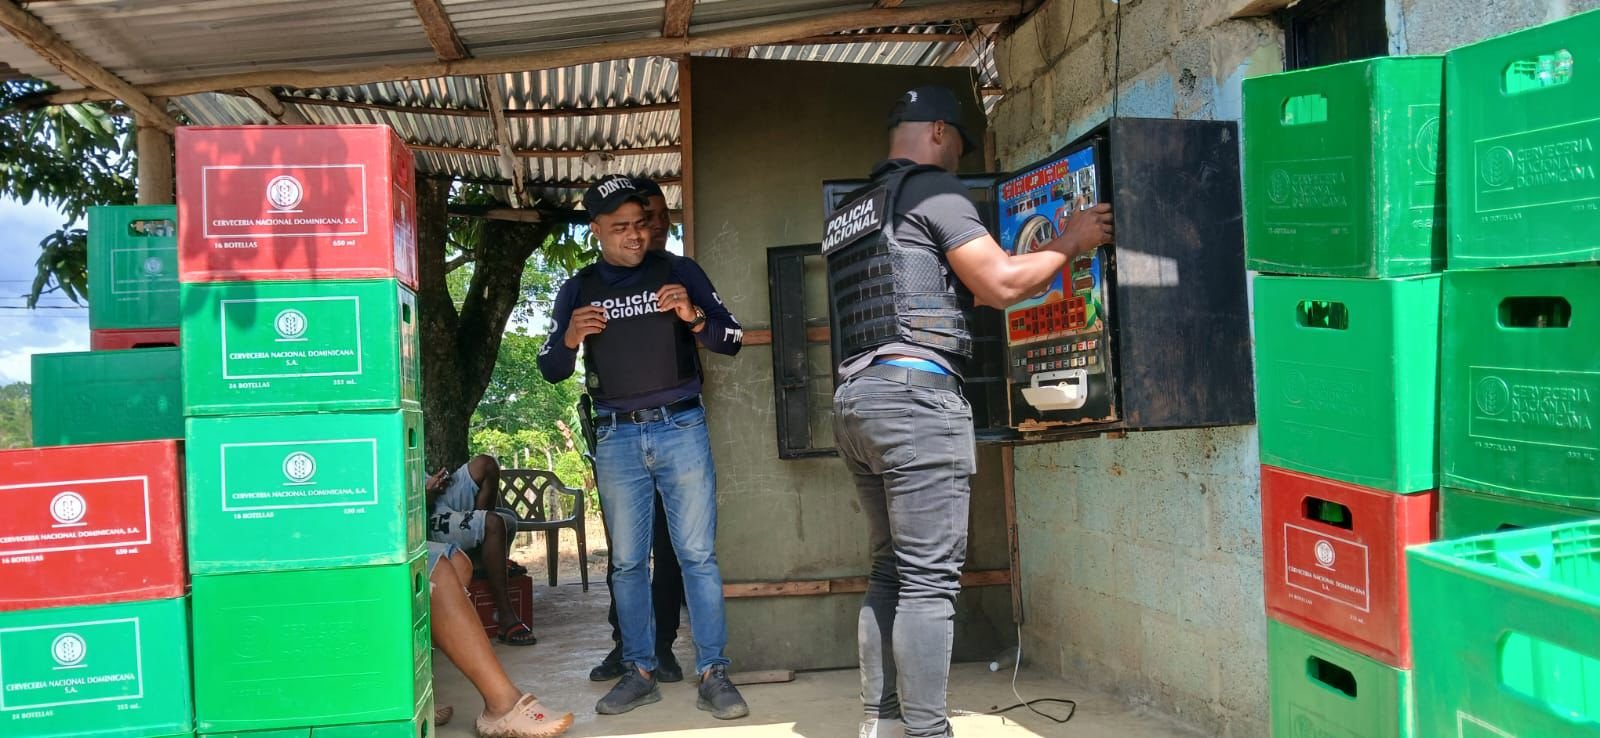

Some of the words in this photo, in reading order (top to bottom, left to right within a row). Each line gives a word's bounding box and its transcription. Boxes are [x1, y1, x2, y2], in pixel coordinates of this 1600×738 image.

[212, 218, 255, 227] CERVECERIA
[256, 218, 294, 226] NACIONAL
[821, 211, 879, 254] NACIONAL
[223, 241, 258, 249] BOTELLAS
[602, 301, 661, 320] ACIONAL
[229, 352, 270, 360] CERVECERIA
[271, 351, 307, 359] NACIONAL
[308, 349, 354, 358] DOMINICANA
[238, 381, 270, 389] BOTELLAS
[272, 490, 307, 498] NACIONAL
[242, 511, 274, 519] BOTELLAS
[41, 532, 77, 540] NACIONAL
[11, 554, 44, 564] BOTELLAS
[6, 681, 48, 692] CERVECERIA
[48, 677, 86, 688] NACIONAL
[87, 673, 136, 684] DOMINICANA
[64, 686, 78, 694] S.A.
[21, 710, 54, 720] BOTELLAS
